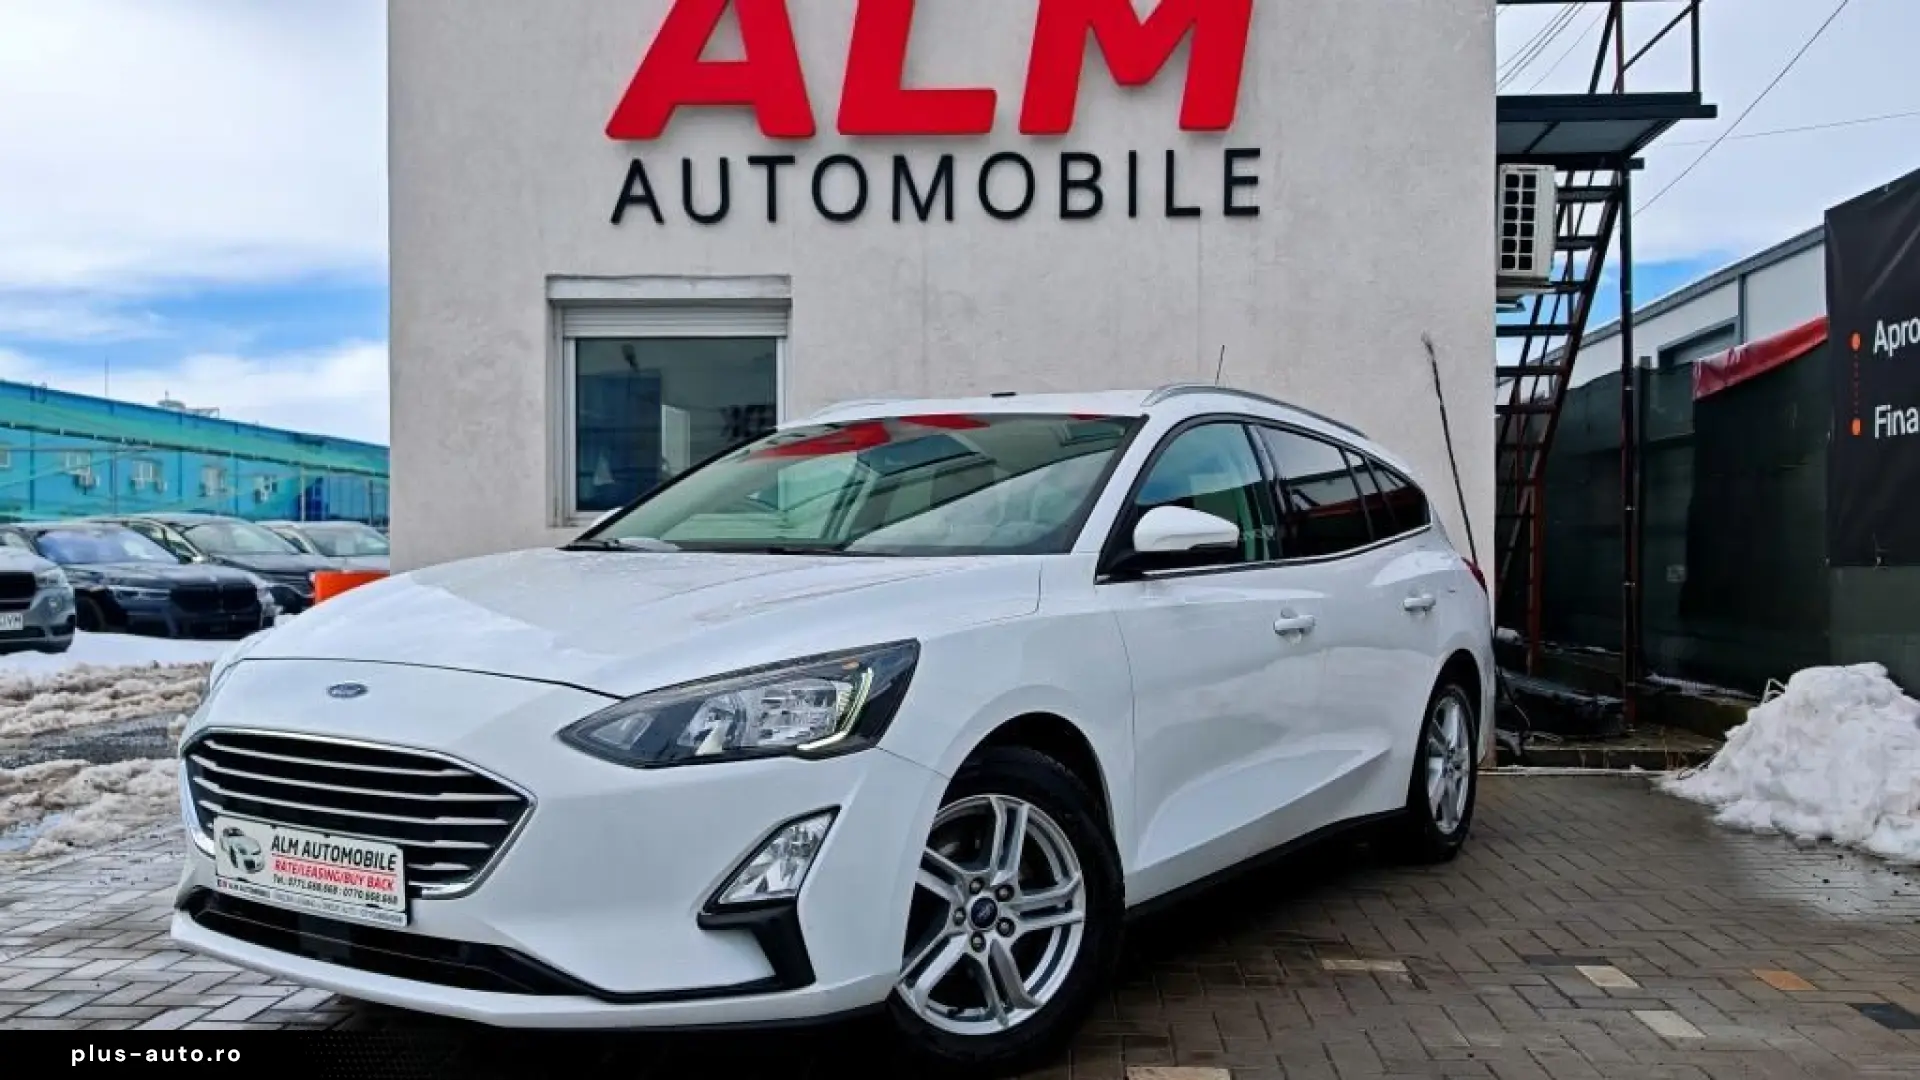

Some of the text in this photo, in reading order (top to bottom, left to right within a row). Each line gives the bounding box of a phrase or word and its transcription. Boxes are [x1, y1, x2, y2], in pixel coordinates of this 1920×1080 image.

[605, 0, 1254, 139] ALM
[610, 147, 1261, 224] AUTOMOBILE
[1873, 316, 1920, 359] Apro
[1874, 404, 1920, 439] Fina
[271, 834, 397, 871] ALM AUTOMOBILE
[367, 874, 394, 891] BACK
